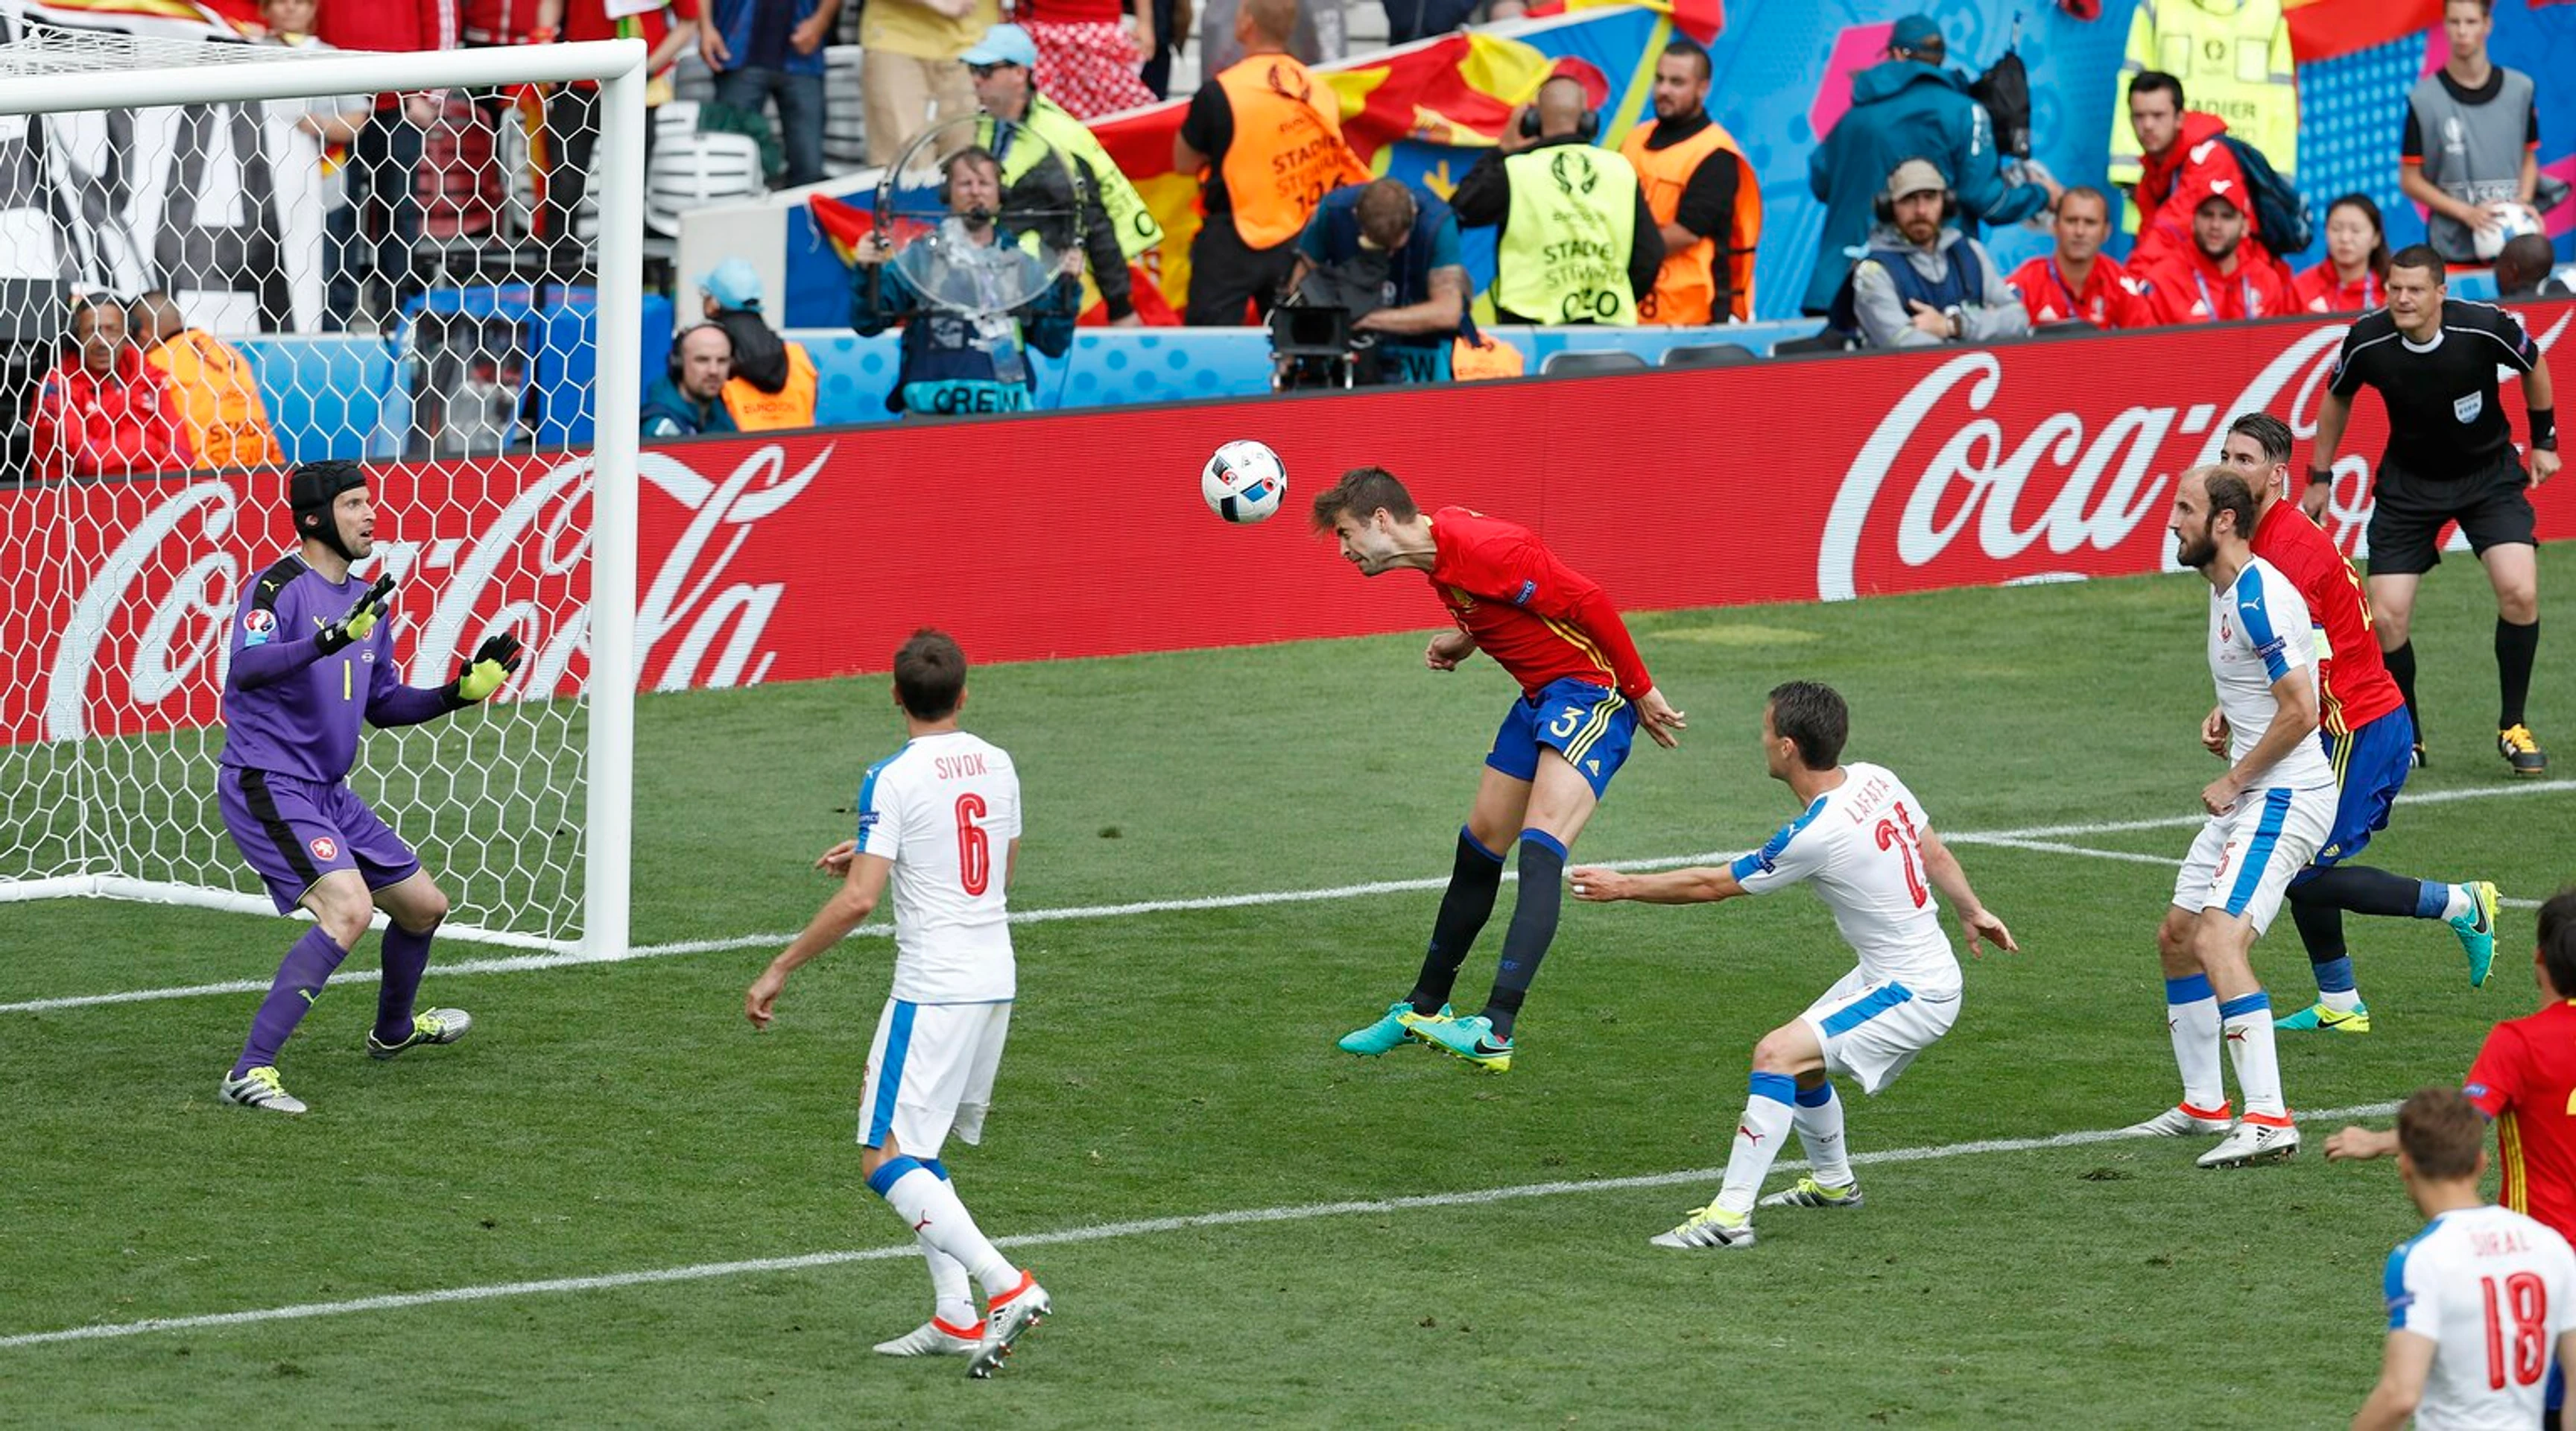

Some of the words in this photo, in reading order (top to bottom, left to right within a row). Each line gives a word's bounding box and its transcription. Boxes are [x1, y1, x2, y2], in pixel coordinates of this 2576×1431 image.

[933, 387, 1022, 414] CREW
[343, 659, 352, 701] 1
[1550, 706, 1586, 738] 3
[935, 753, 987, 780] SIVOK
[1844, 775, 1890, 825] LAFATA
[955, 792, 990, 897] 6
[2480, 1271, 2547, 1390] 18
